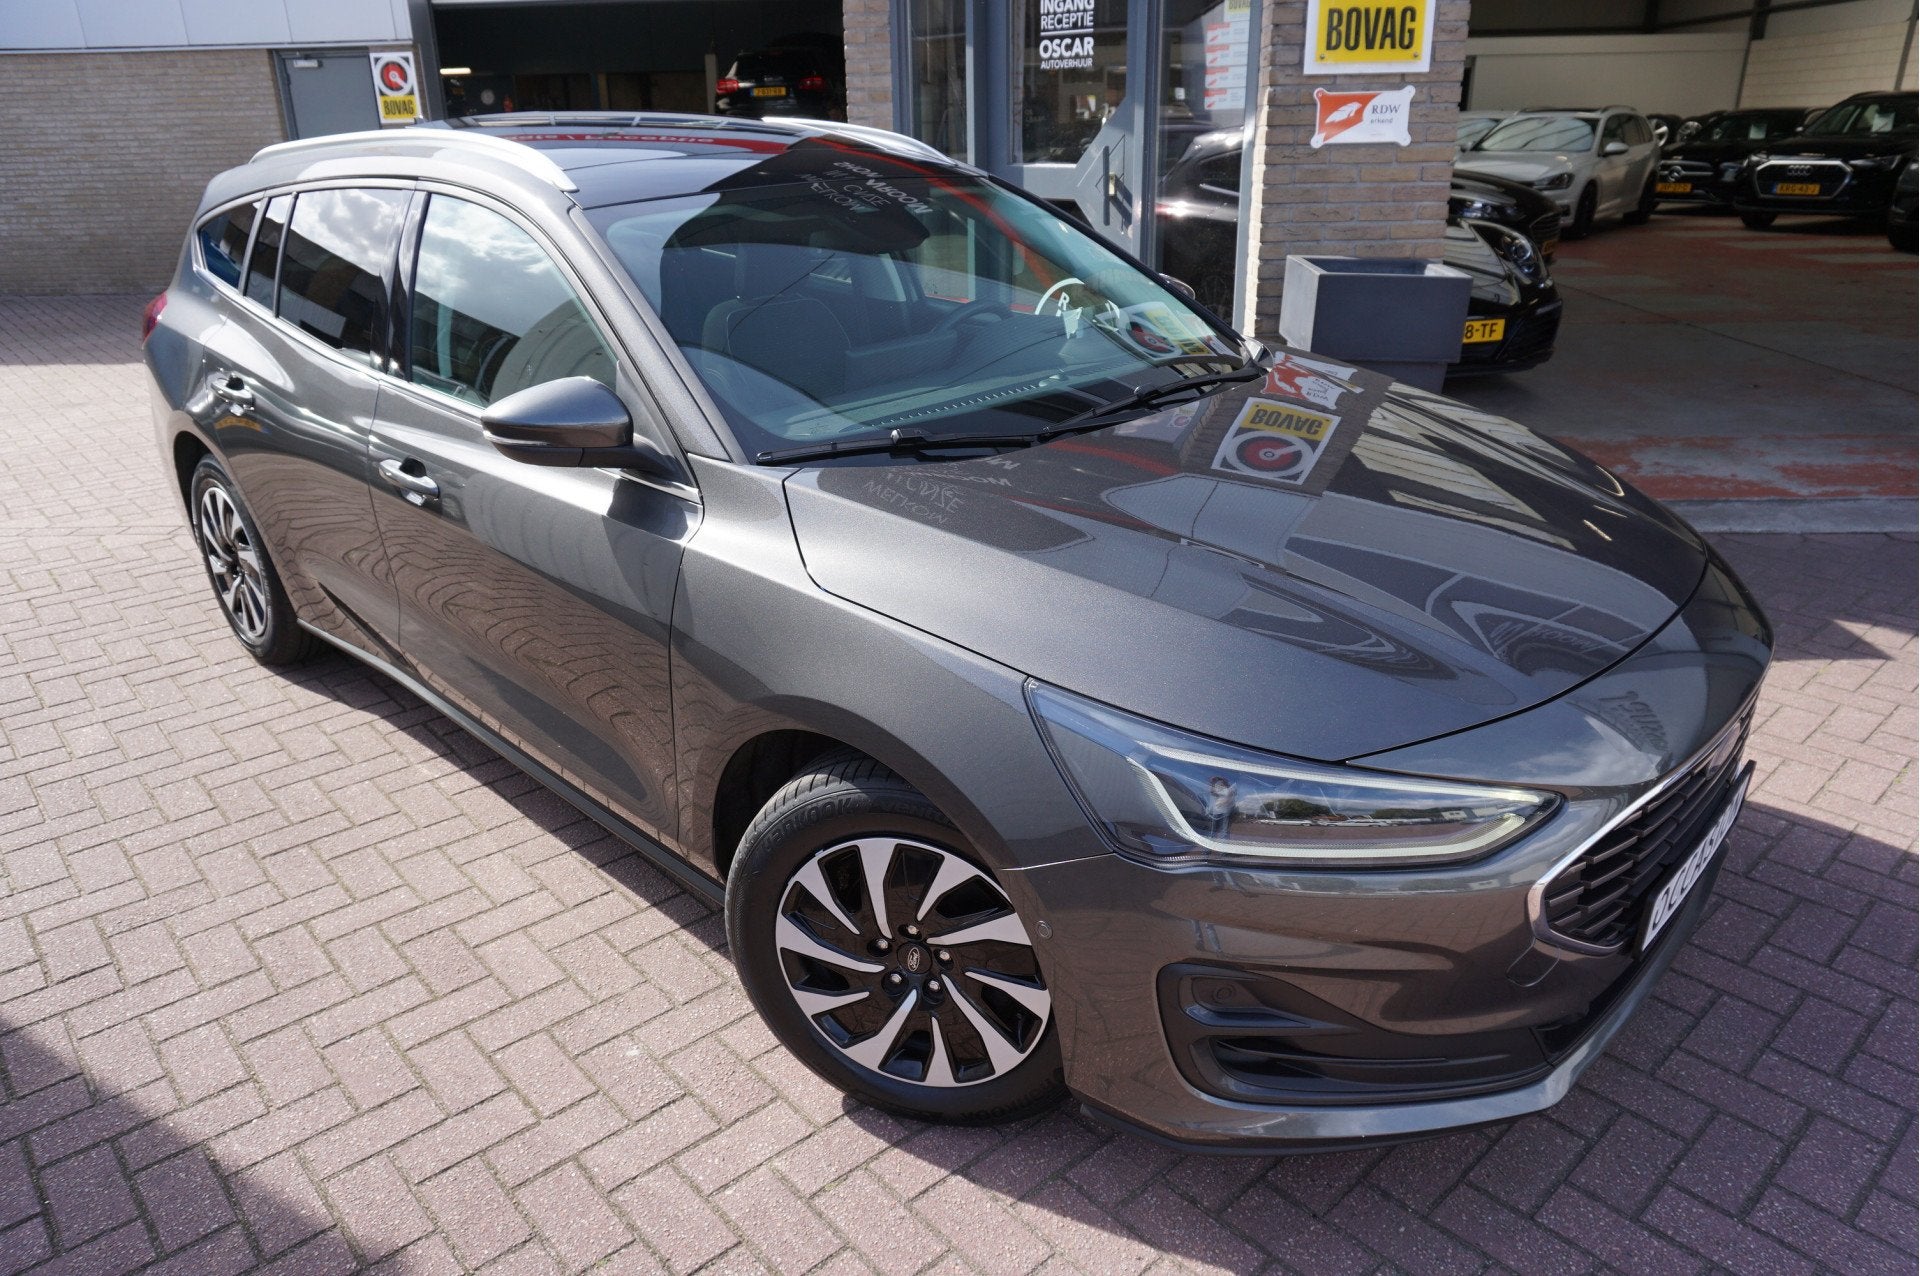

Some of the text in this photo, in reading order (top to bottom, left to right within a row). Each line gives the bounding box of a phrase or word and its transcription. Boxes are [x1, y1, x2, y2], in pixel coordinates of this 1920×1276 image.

[1040, 0, 1095, 14] INGANG
[1041, 11, 1094, 30] RECEPTIE
[1325, 6, 1417, 51] BOVAG
[1039, 36, 1095, 59] OSCAR
[1040, 57, 1093, 70] AUTOVERHUUR
[383, 99, 415, 116] BOVAG
[1371, 104, 1401, 115] RDW
